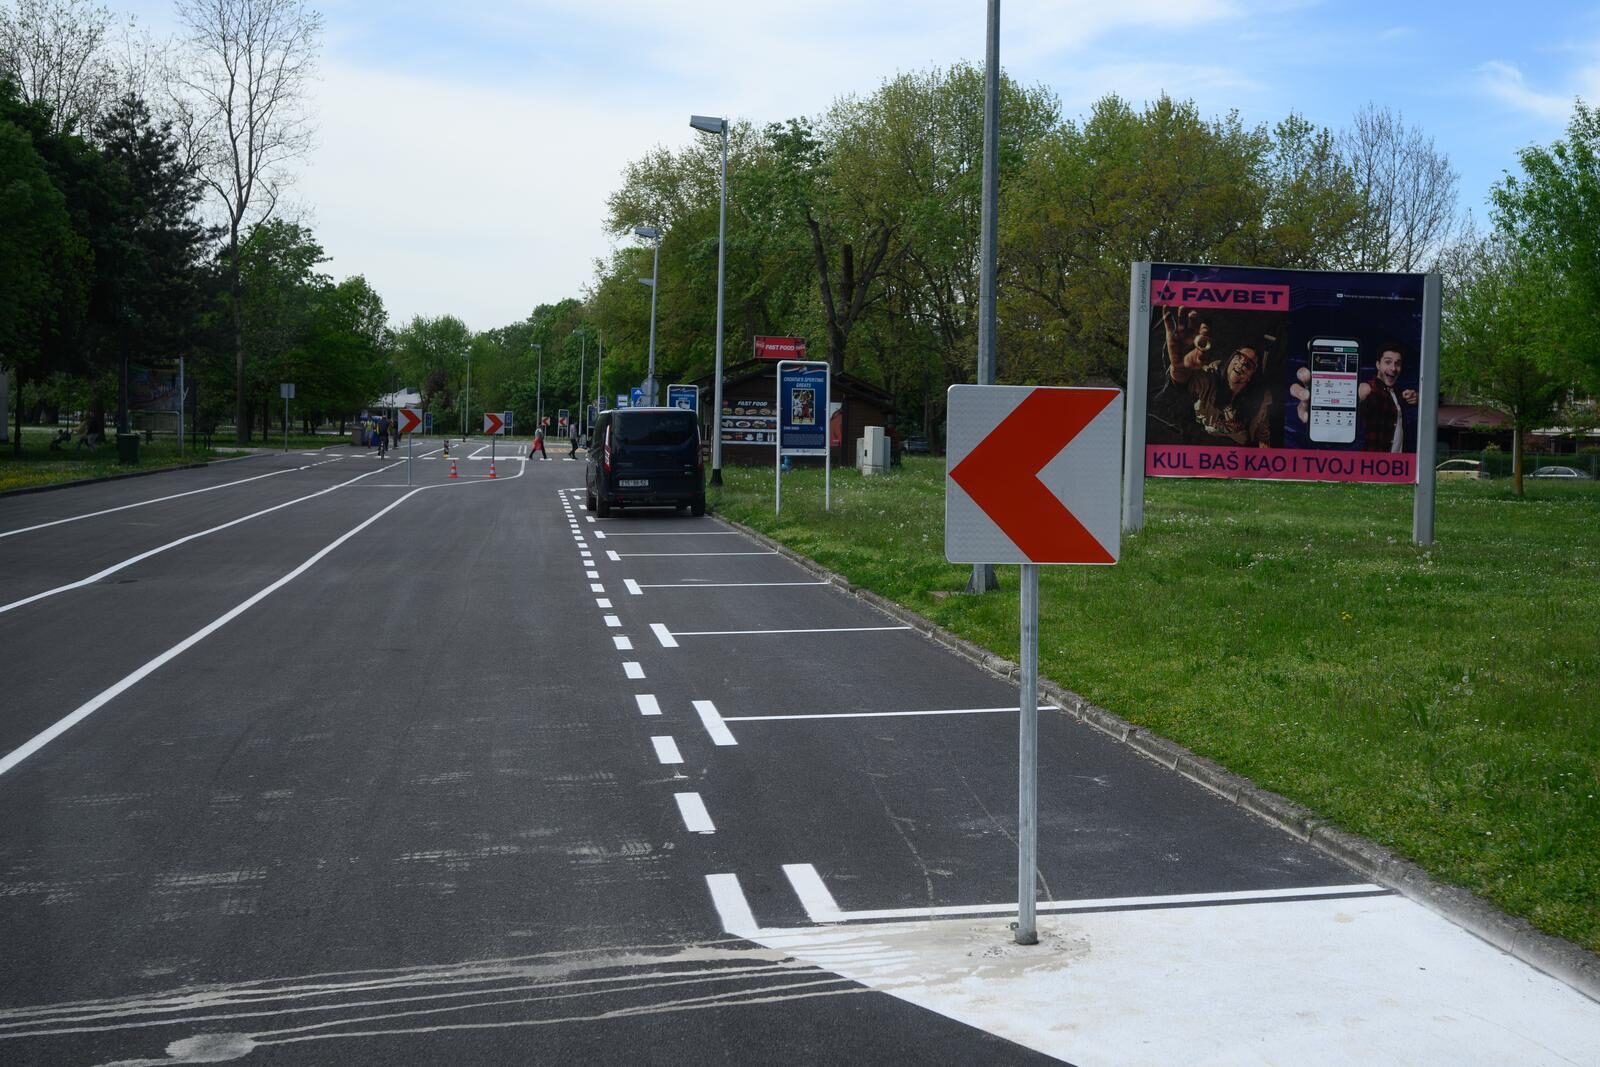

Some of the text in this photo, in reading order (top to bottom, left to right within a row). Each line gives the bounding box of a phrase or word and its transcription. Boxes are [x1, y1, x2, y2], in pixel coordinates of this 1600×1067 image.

[1182, 287, 1284, 305] FAVBET
[1153, 451, 1409, 476] KUL BAŠ KAO I TVOJ HOBI
